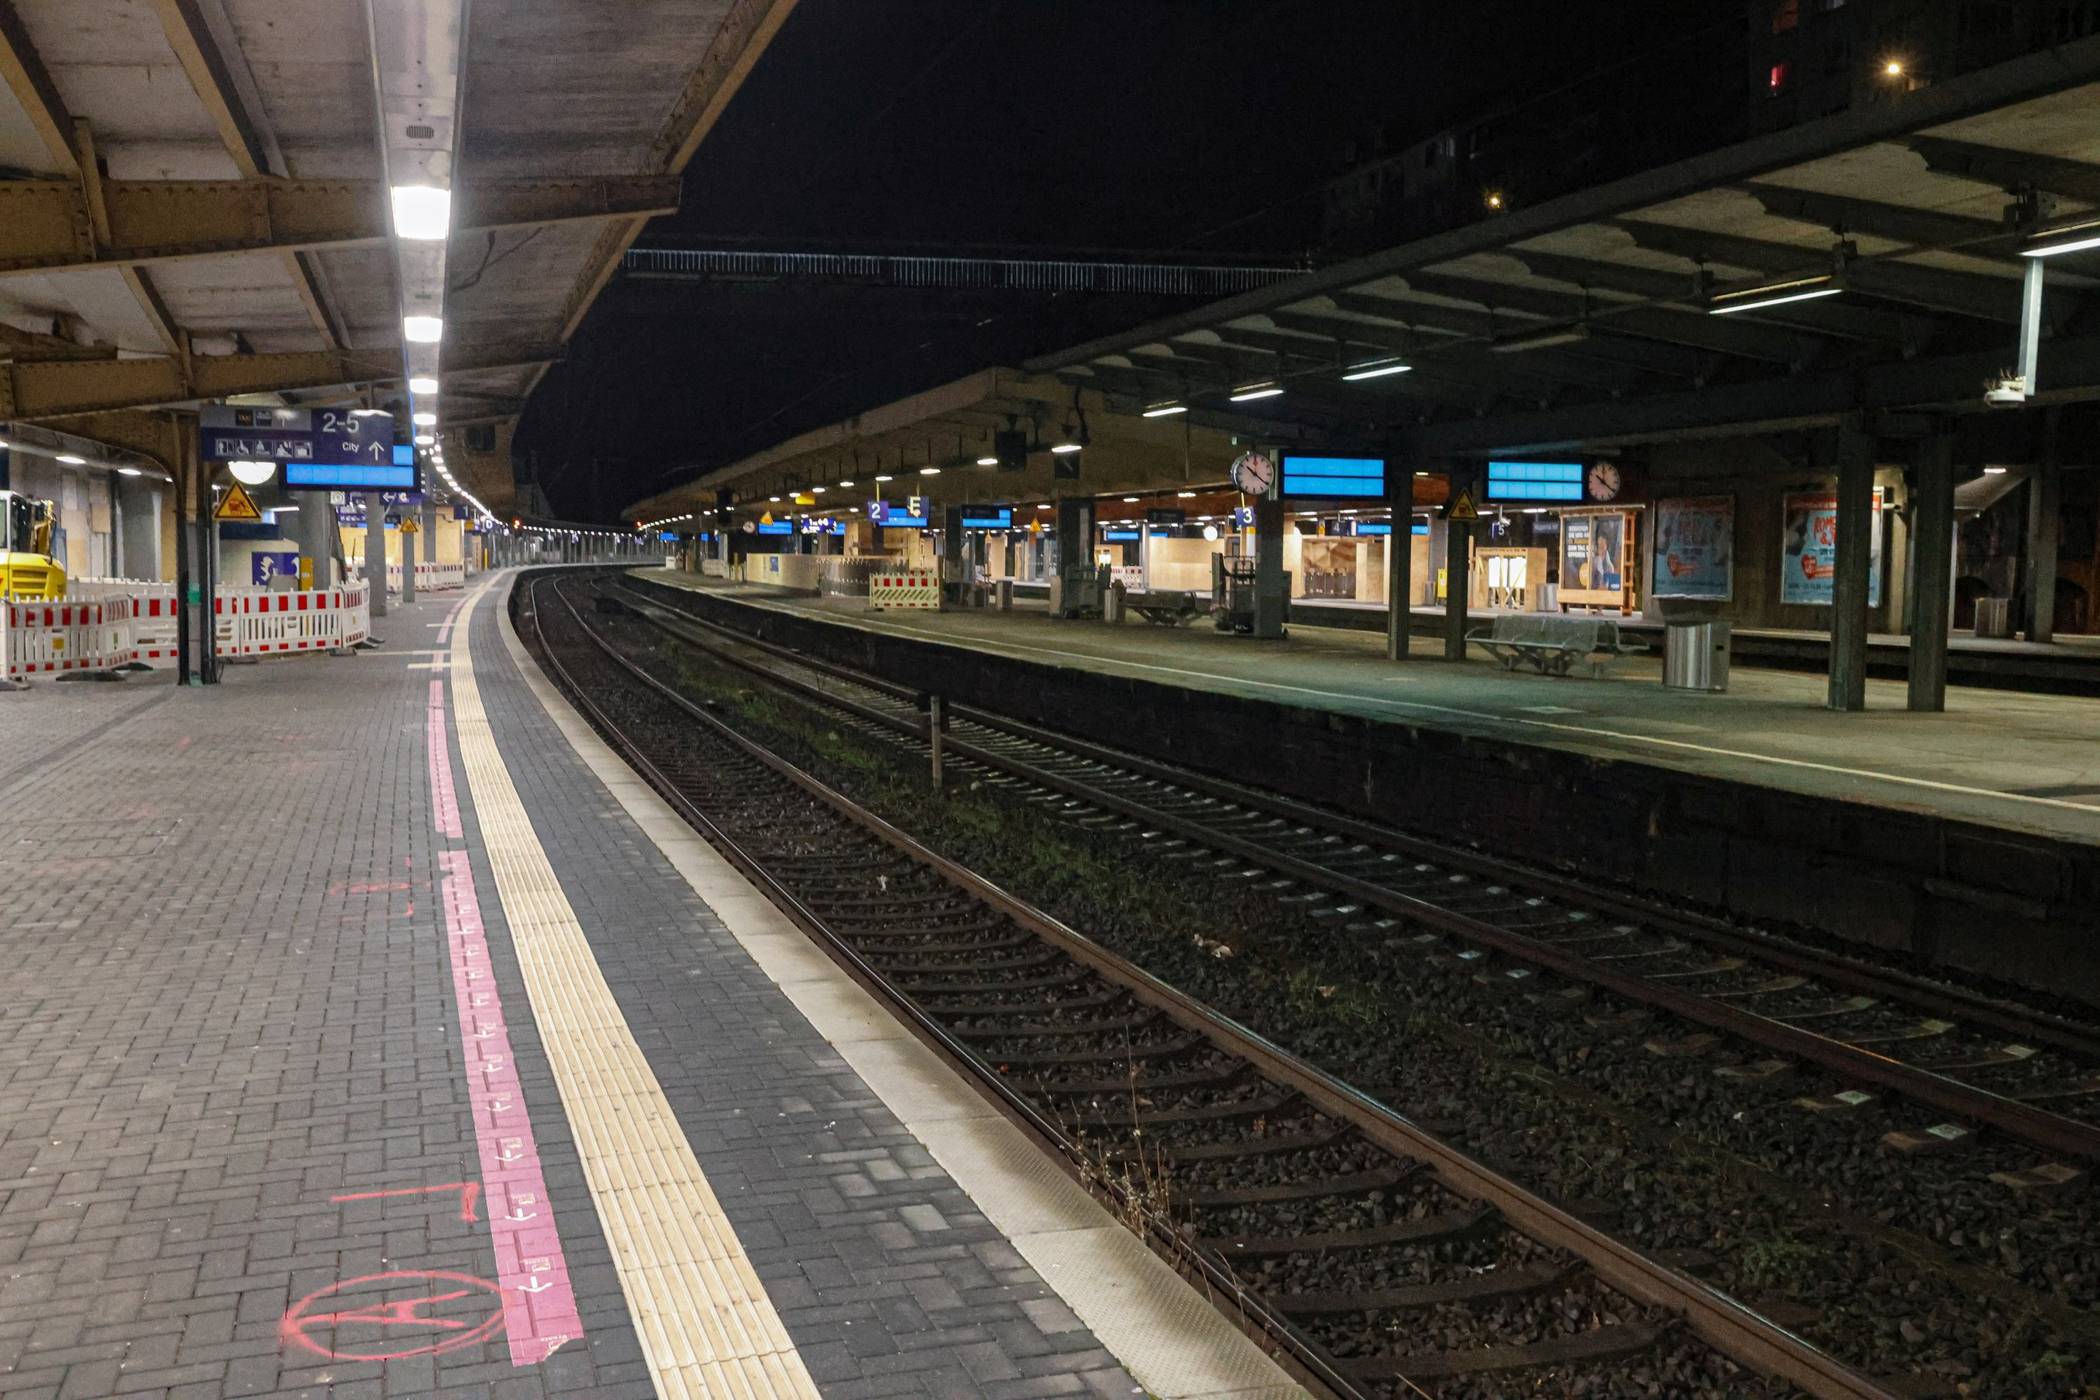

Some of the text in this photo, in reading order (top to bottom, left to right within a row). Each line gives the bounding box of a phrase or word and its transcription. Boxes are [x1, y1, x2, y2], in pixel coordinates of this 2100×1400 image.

[323, 412, 360, 433] 2-5
[342, 442, 360, 453] City
[871, 503, 880, 518] 2
[1243, 508, 1253, 524] 3
